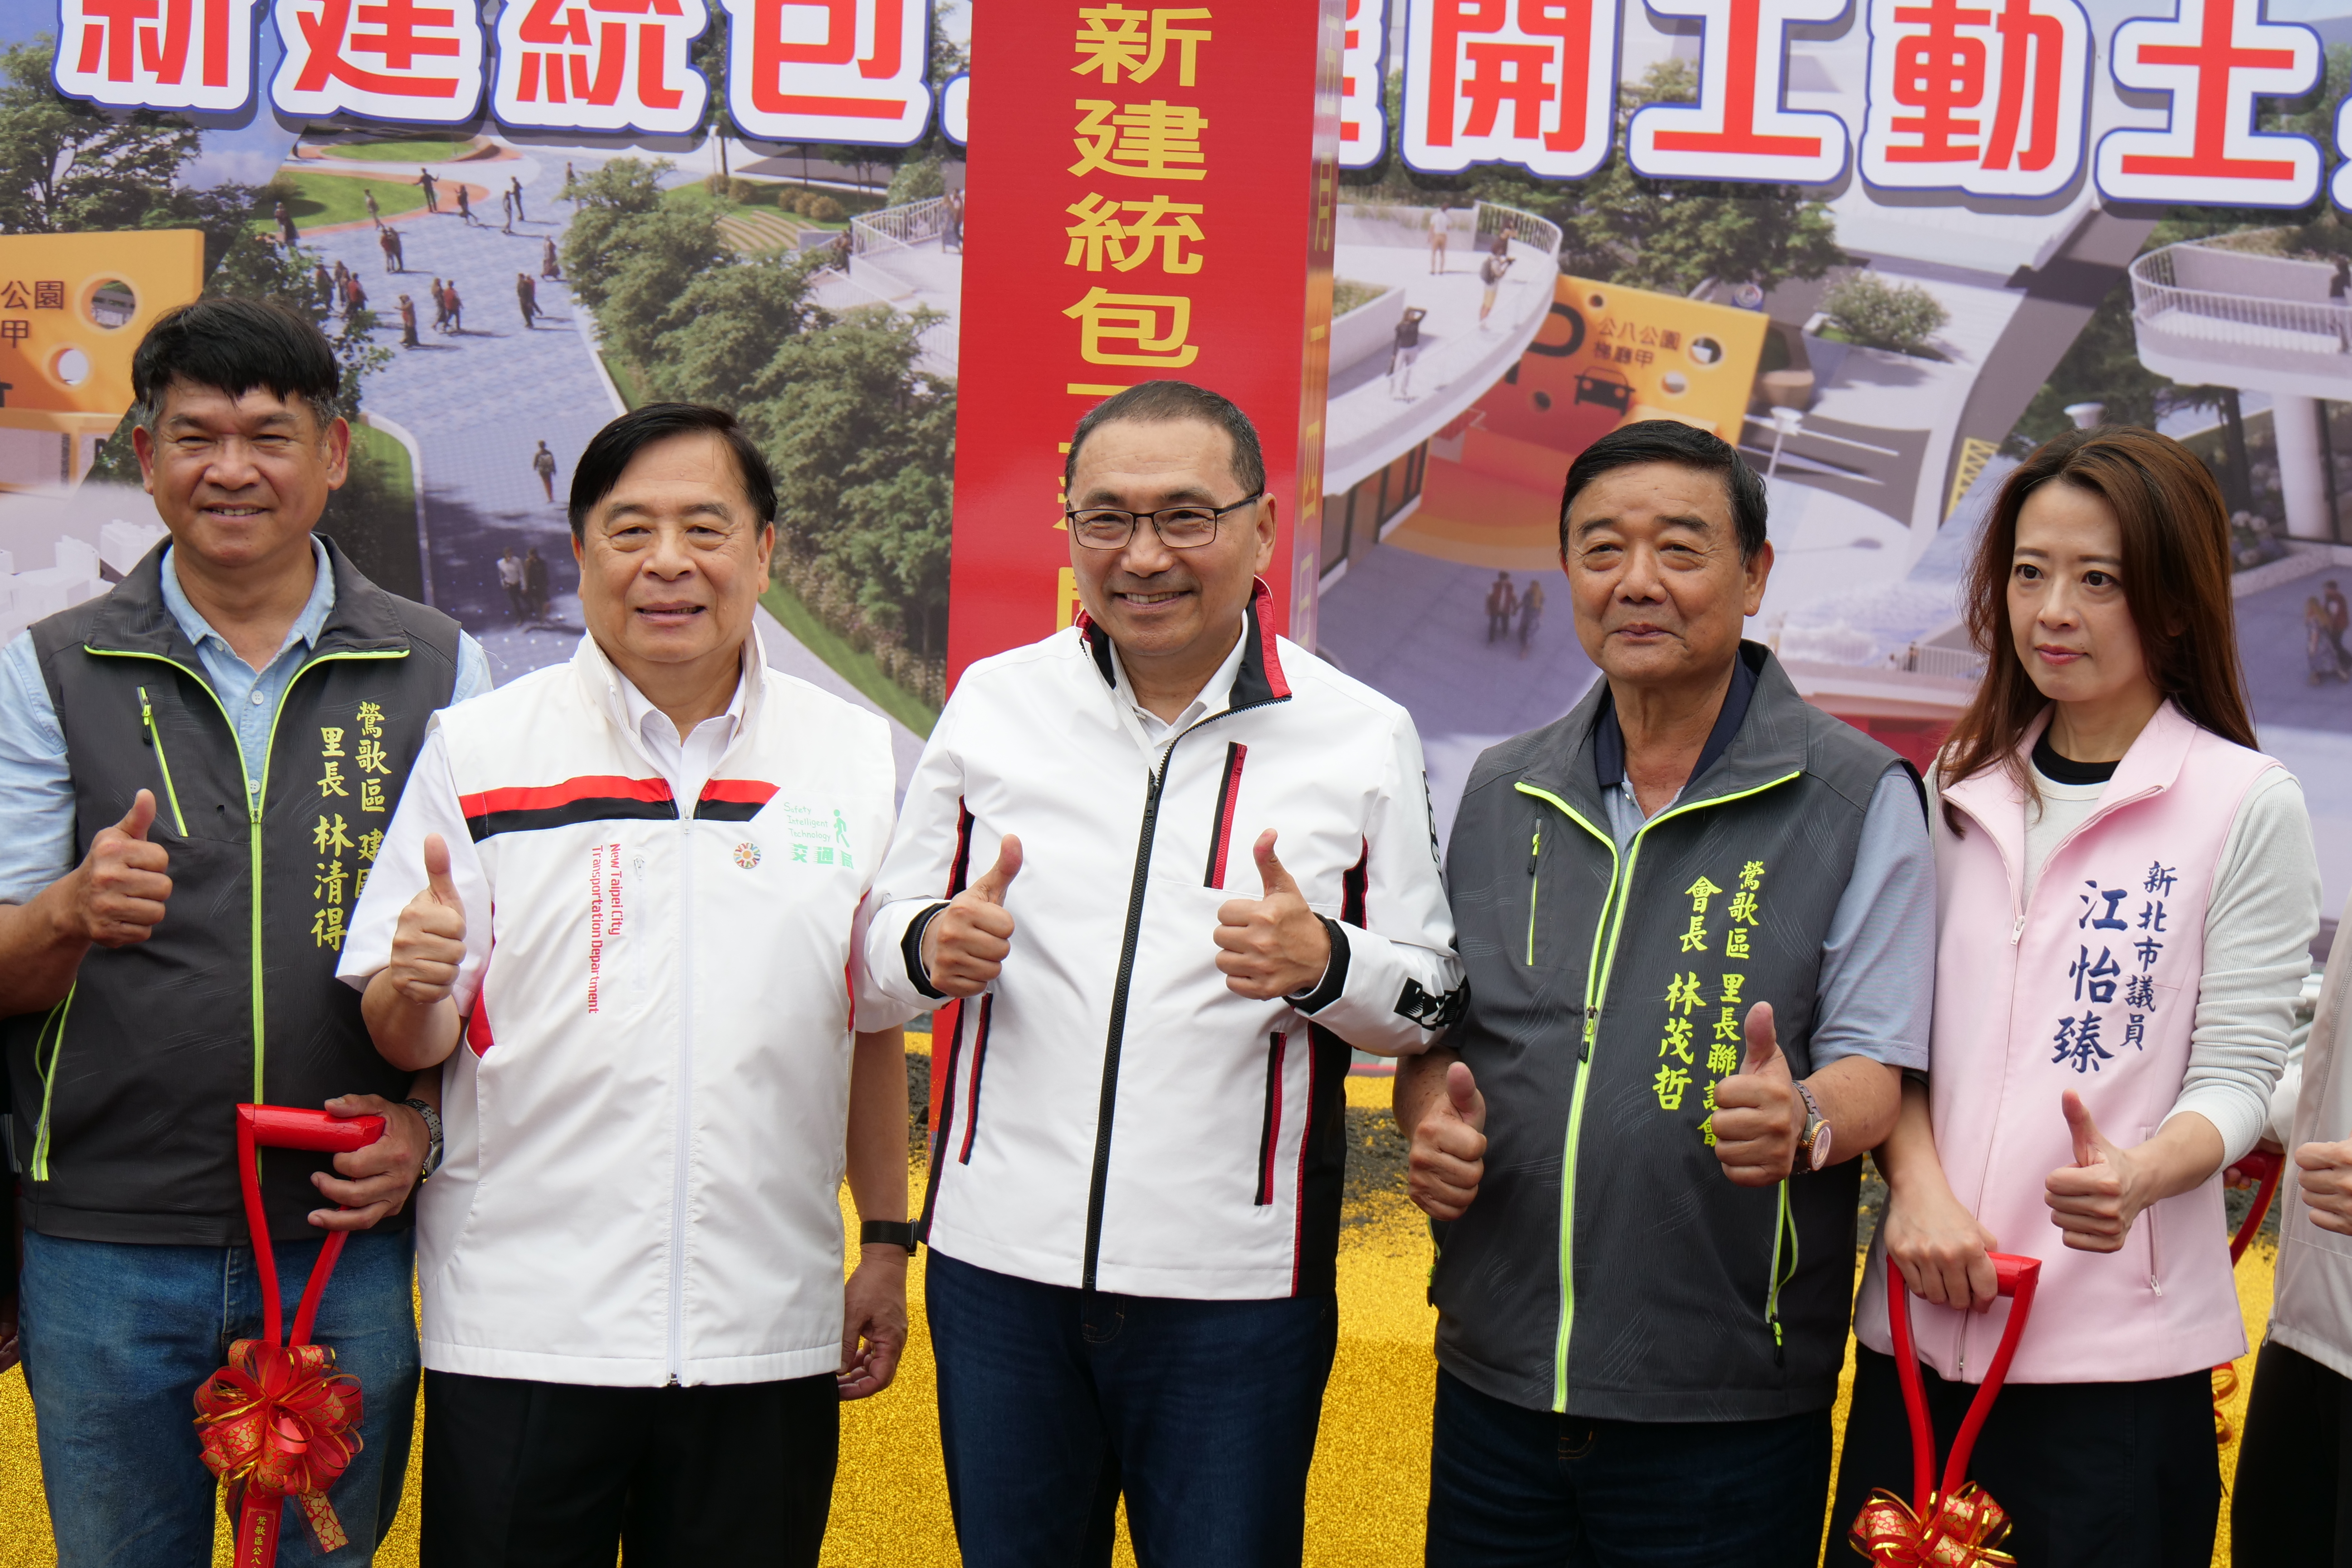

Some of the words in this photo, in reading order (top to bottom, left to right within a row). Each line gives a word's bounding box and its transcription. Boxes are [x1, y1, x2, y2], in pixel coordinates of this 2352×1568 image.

[1341, 0, 2295, 180] 開工動土
[317, 727, 349, 797] 里長
[355, 701, 392, 812] 鶯歌區
[784, 802, 812, 815] Safety
[787, 815, 828, 828] Intelligent
[788, 828, 831, 842] Technology
[311, 813, 354, 951] 林清得
[590, 845, 604, 938] Transportation
[609, 871, 623, 908] Taipei
[610, 843, 621, 868] New
[789, 843, 854, 870] 交通局
[608, 910, 623, 936] City
[1679, 876, 1723, 953] 會長
[1726, 861, 1765, 960] 鶯歌區
[588, 940, 603, 1014] Department
[2051, 880, 2128, 1073] 江怡臻
[2119, 861, 2178, 1051] 新北市議員
[1652, 971, 1707, 1110] 林茂哲
[250, 1516, 267, 1568] 鶯歌區公八
